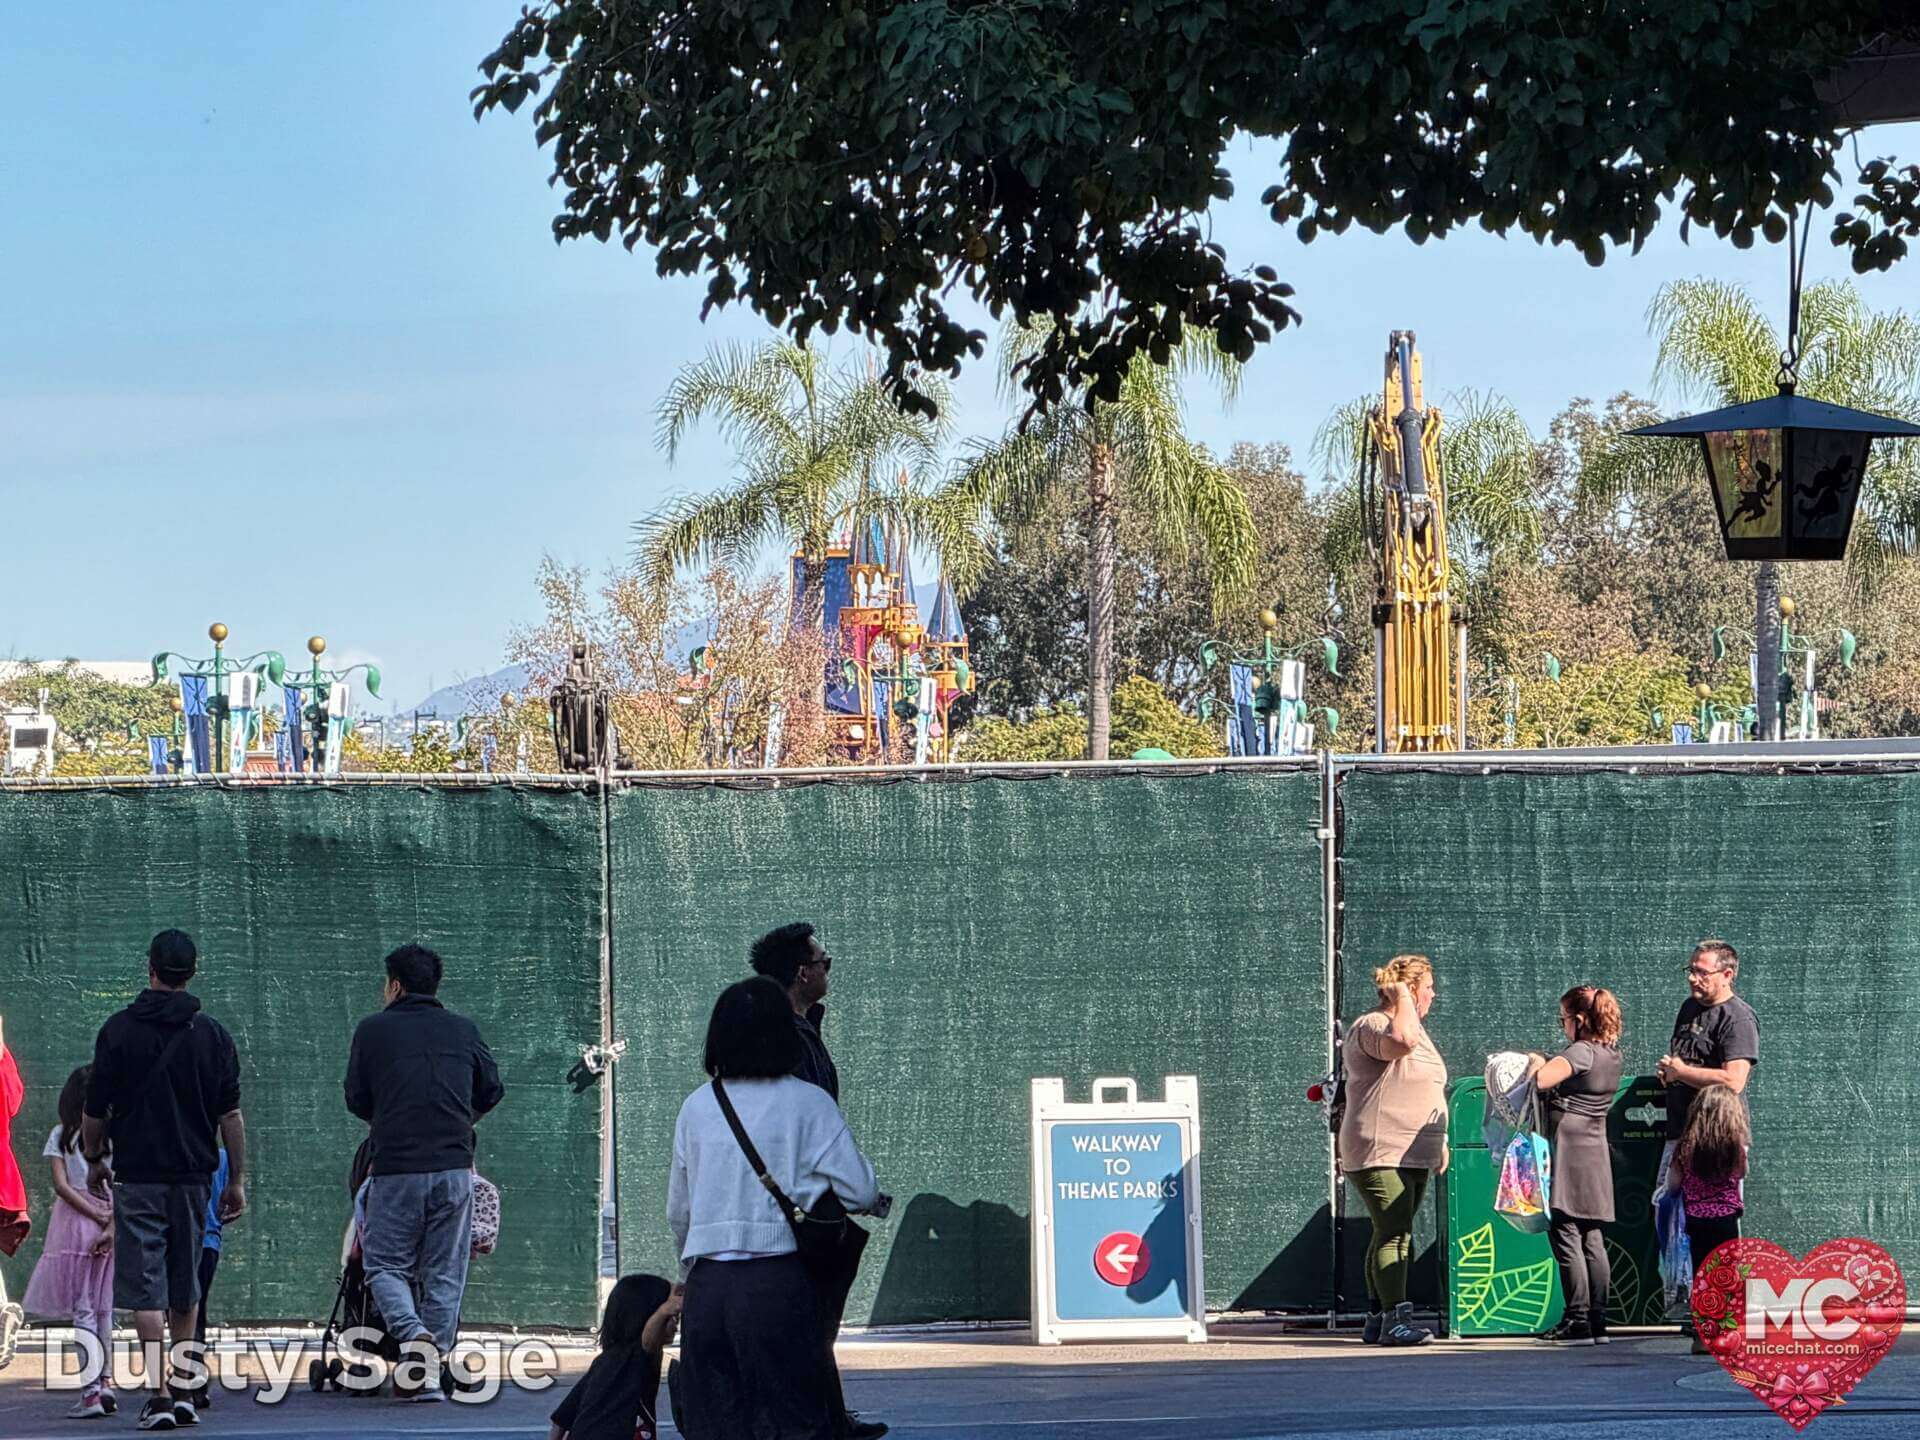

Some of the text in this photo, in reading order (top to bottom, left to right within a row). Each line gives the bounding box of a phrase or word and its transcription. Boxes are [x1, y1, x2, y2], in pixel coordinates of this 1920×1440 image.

[1072, 1135, 1161, 1152] WALKWAY
[1103, 1158, 1131, 1175] TO
[1058, 1181, 1177, 1200] THEME PARKS
